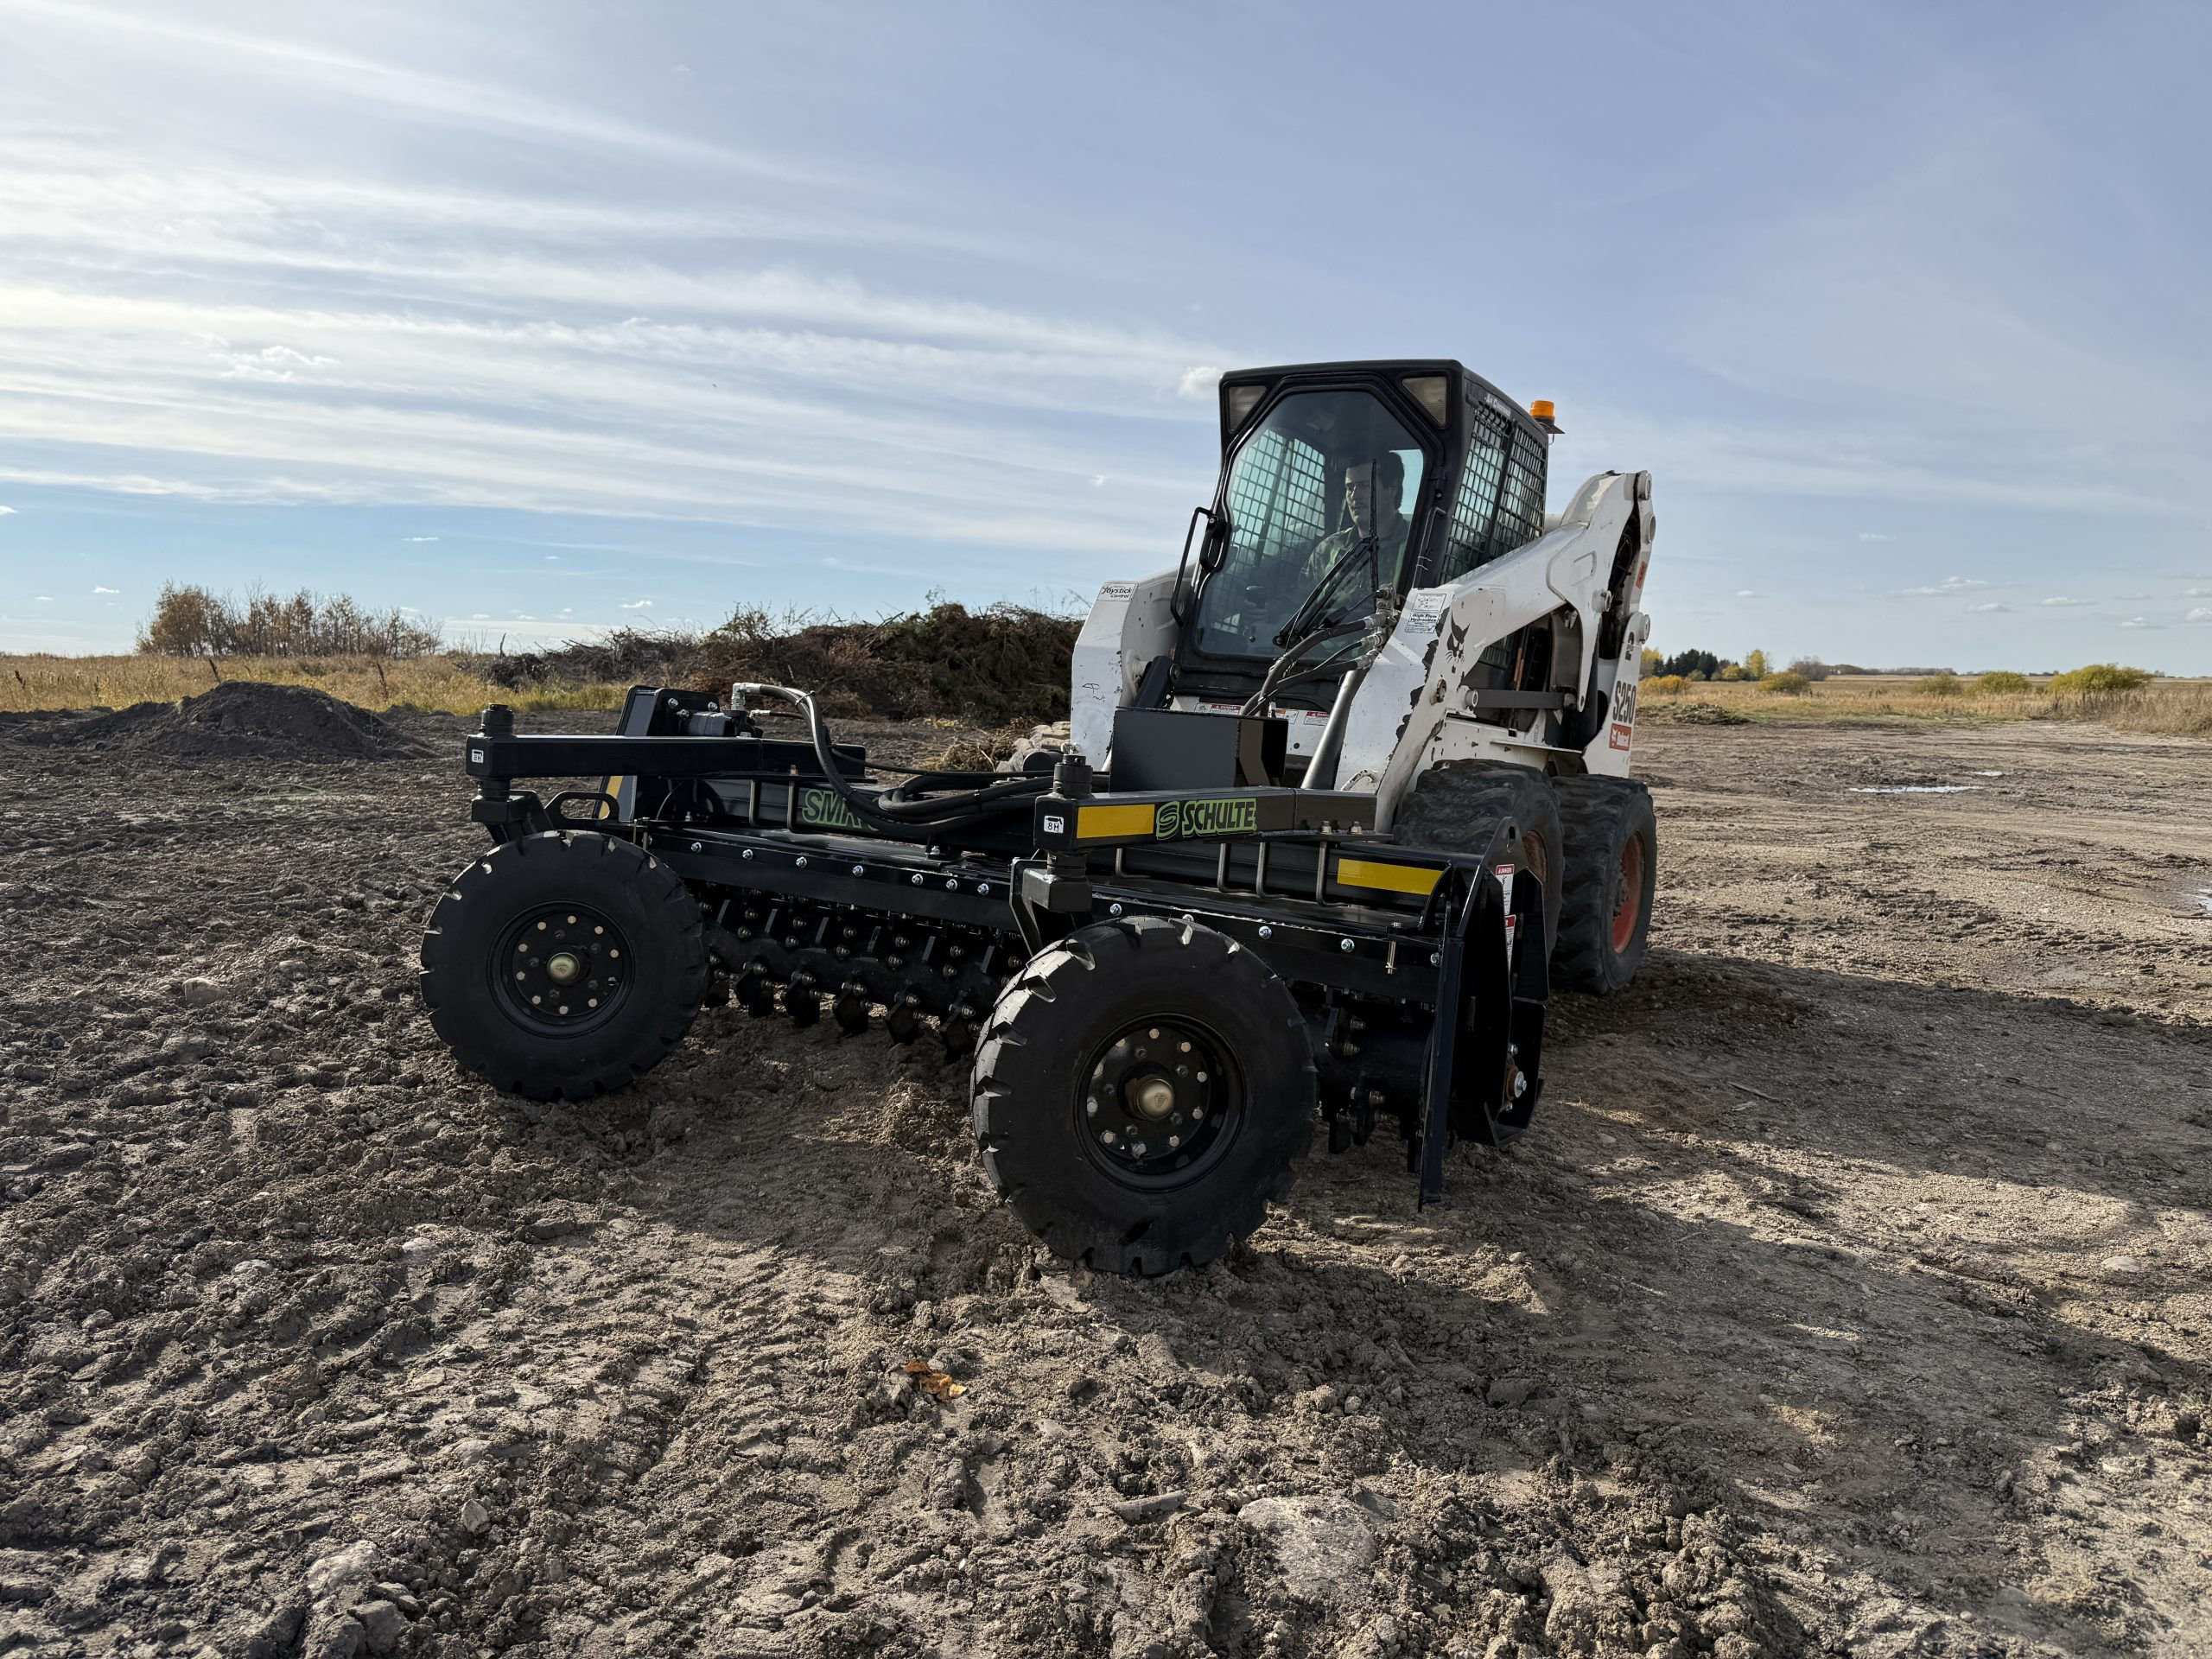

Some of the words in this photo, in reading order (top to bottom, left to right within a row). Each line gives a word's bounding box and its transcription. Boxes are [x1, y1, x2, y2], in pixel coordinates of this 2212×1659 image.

[1101, 586, 1133, 594] Joystick
[1612, 680, 1637, 724] S250
[1048, 822, 1059, 831] 8H
[1182, 799, 1256, 836] SCHULTE
